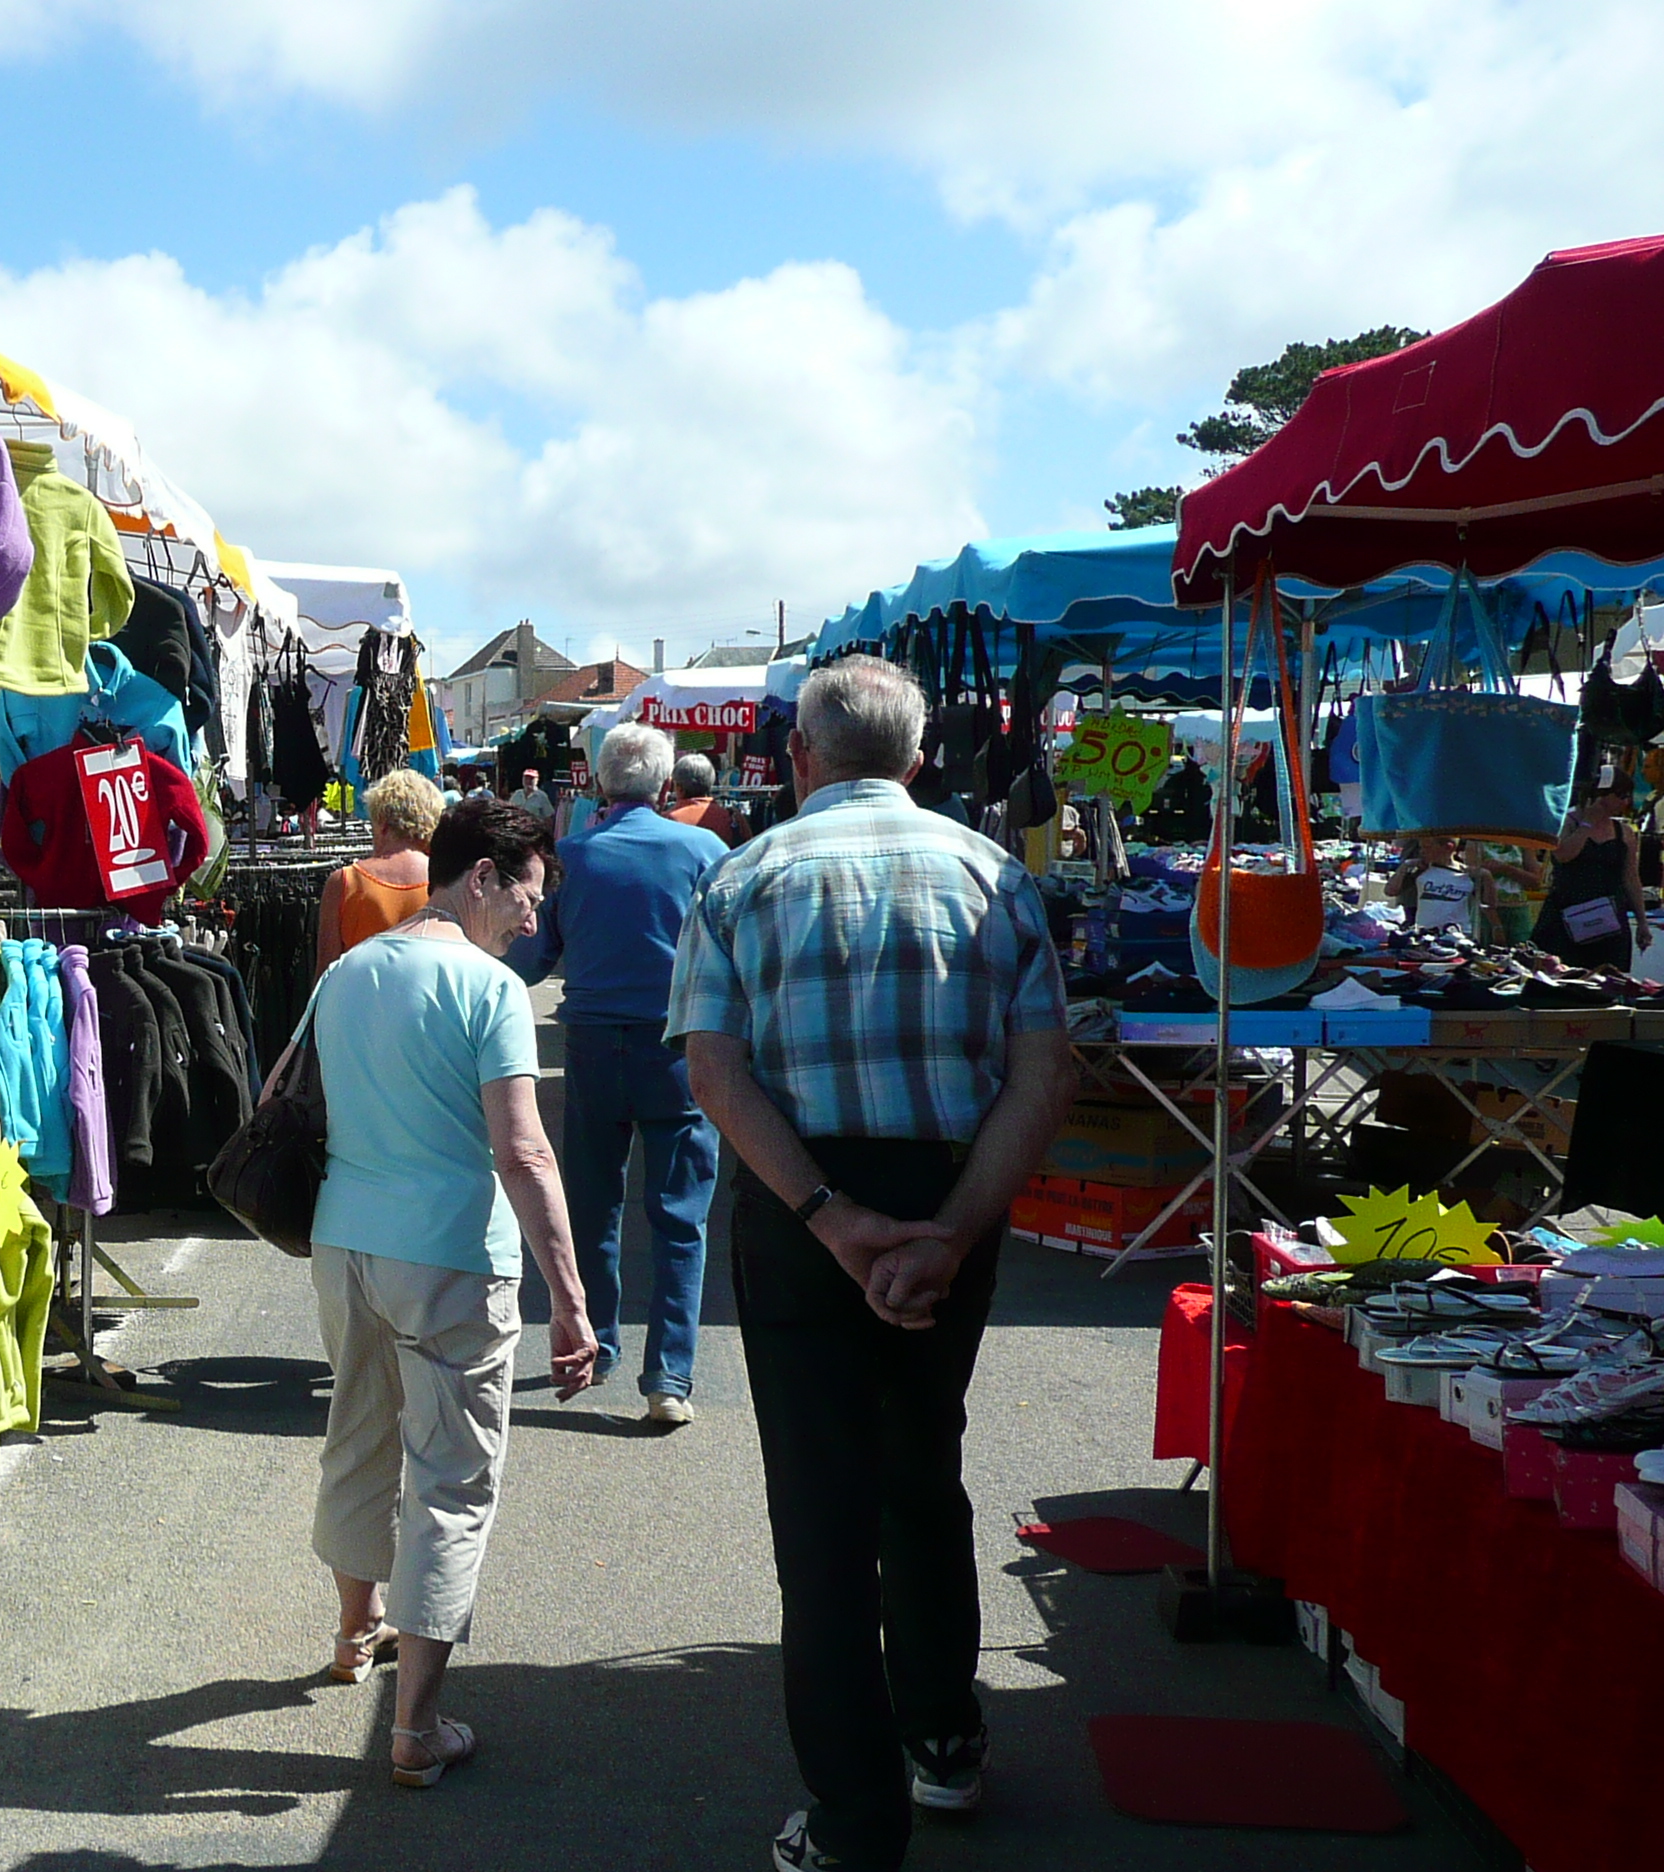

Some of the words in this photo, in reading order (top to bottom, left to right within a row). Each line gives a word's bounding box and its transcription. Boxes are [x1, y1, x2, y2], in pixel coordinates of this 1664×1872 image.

[648, 703, 690, 725] PRIX
[694, 706, 750, 727] CHOC
[571, 771, 587, 786] 10
[98, 771, 149, 852] 20€
[1064, 1222, 1113, 1243] MARTINIQUE
